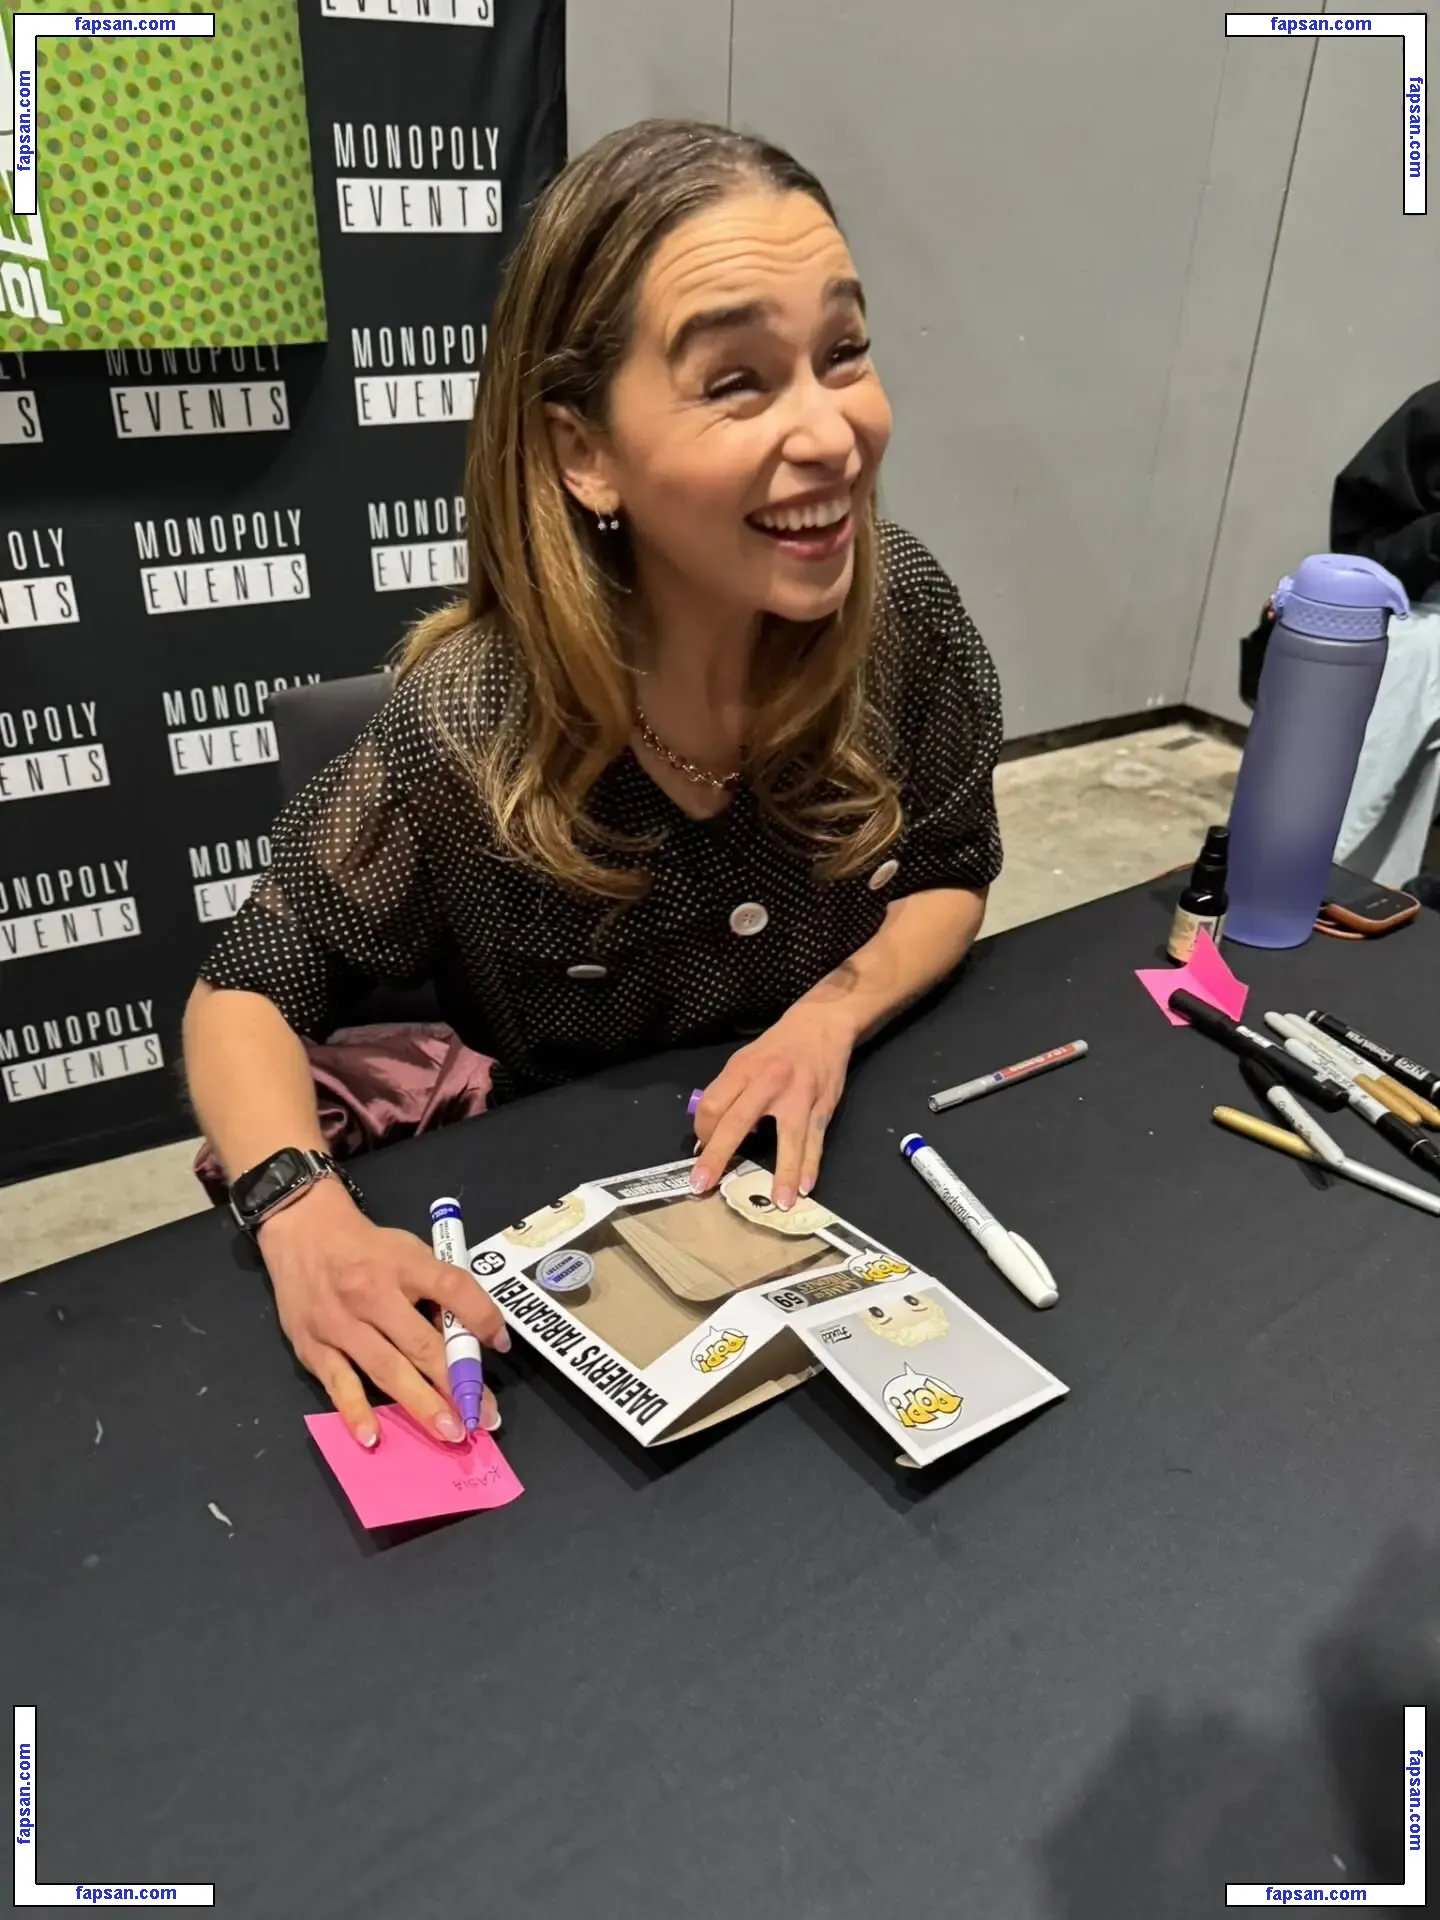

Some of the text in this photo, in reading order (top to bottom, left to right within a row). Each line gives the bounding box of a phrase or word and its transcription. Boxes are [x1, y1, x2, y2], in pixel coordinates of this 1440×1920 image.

[334, 123, 499, 170] MONOPOLY
[344, 184, 499, 227] EVENTS
[352, 324, 487, 368] MONOPO
[116, 386, 285, 433] EVENTS
[134, 509, 301, 560] MONOPOLY
[368, 496, 466, 540] MONOP
[146, 560, 305, 609] EVENTS
[376, 546, 466, 587] EVEN
[0, 701, 98, 748] OPOLY
[174, 726, 272, 770] EVEN
[188, 836, 273, 878] MONO
[2, 902, 135, 954] VENTS
[0, 999, 153, 1062] MONOPOLY
[8, 1039, 159, 1098] EVENTS
[473, 1252, 504, 1274] 59
[773, 1292, 804, 1308] 59
[489, 1276, 669, 1427] DAENERYS TARGARYEN
